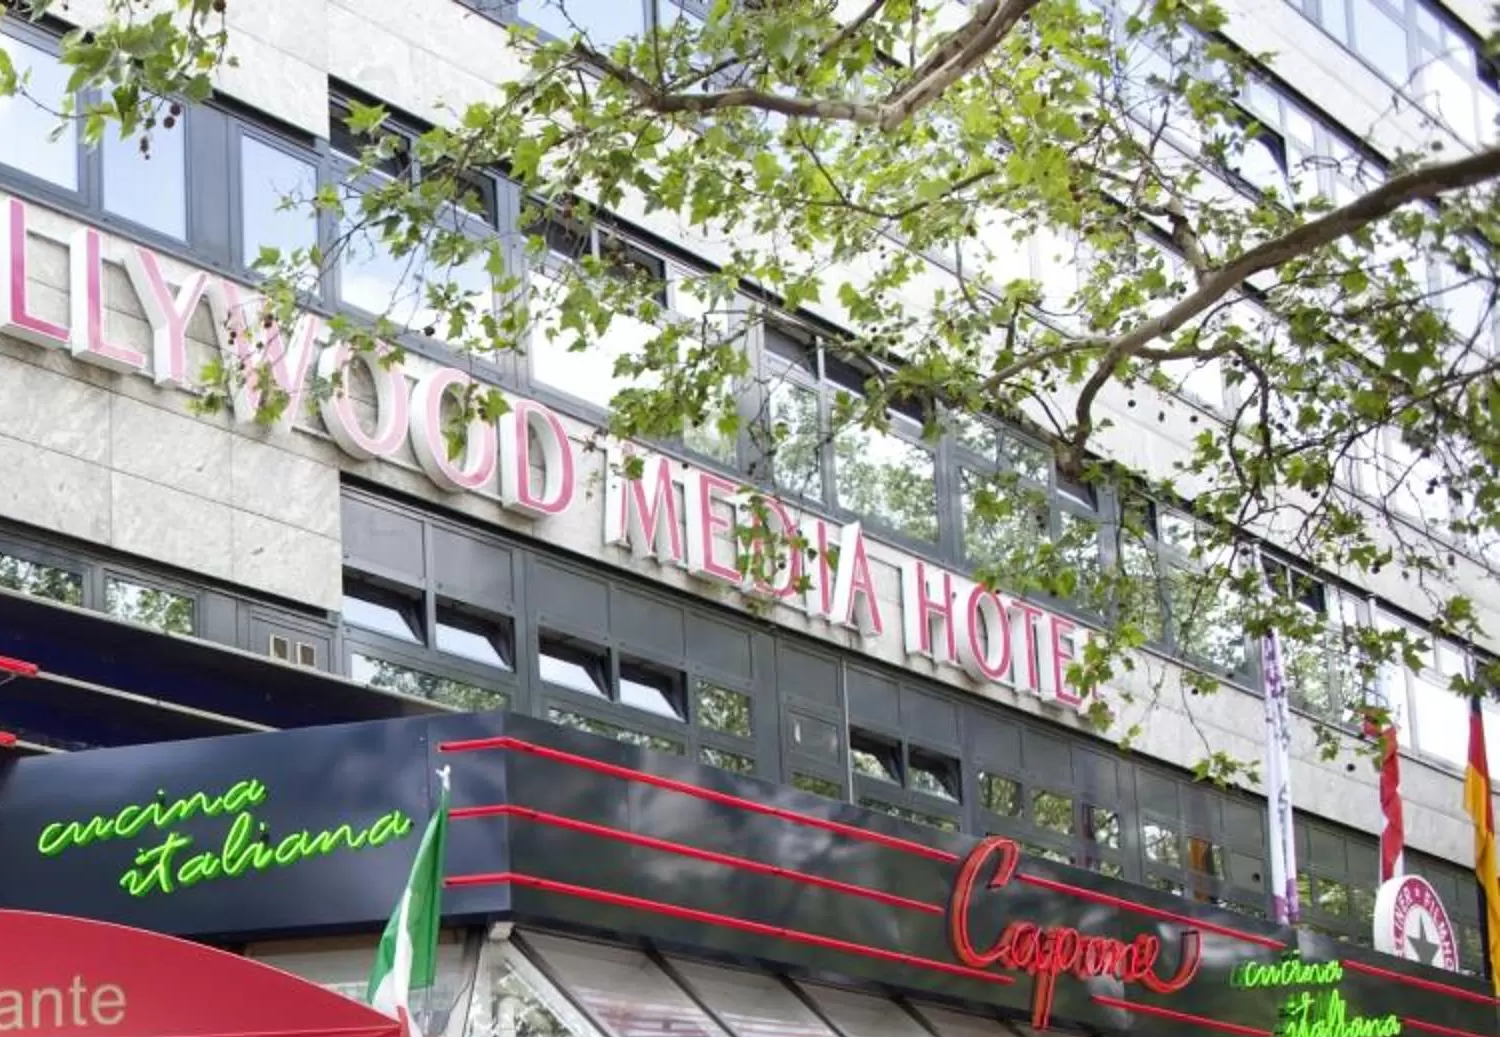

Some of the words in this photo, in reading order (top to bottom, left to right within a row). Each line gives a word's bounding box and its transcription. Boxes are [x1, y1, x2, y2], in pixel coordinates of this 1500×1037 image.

[605, 442, 883, 637] MEDIA
[37, 777, 268, 856] cucina
[119, 809, 413, 897] italiana
[947, 835, 1201, 1031] Capone
